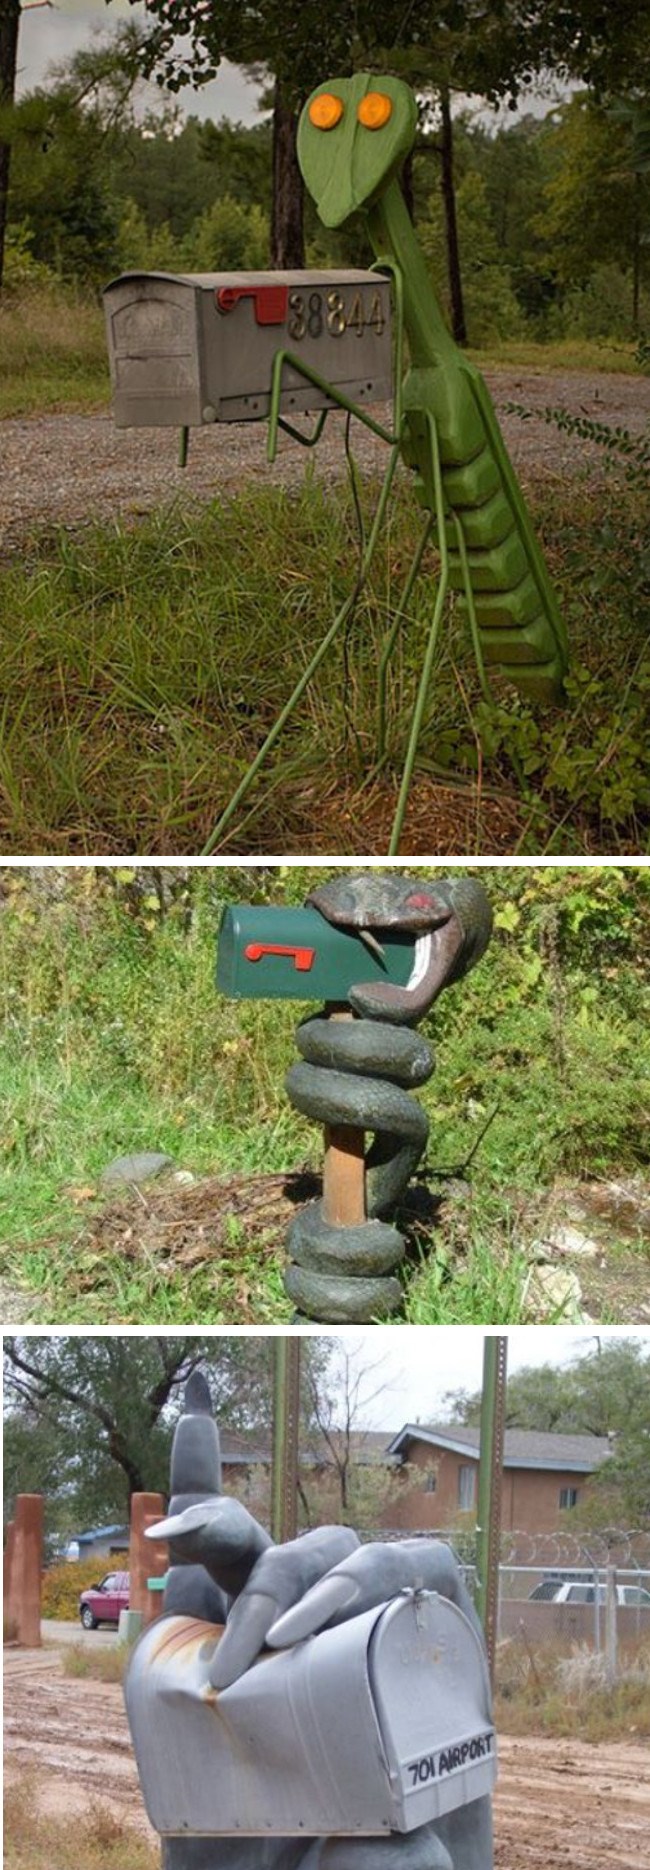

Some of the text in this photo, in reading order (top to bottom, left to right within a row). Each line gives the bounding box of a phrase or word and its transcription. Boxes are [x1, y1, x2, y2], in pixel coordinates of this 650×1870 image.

[289, 290, 385, 340] 38844
[408, 1733, 494, 1786] 701 AIRPORT
